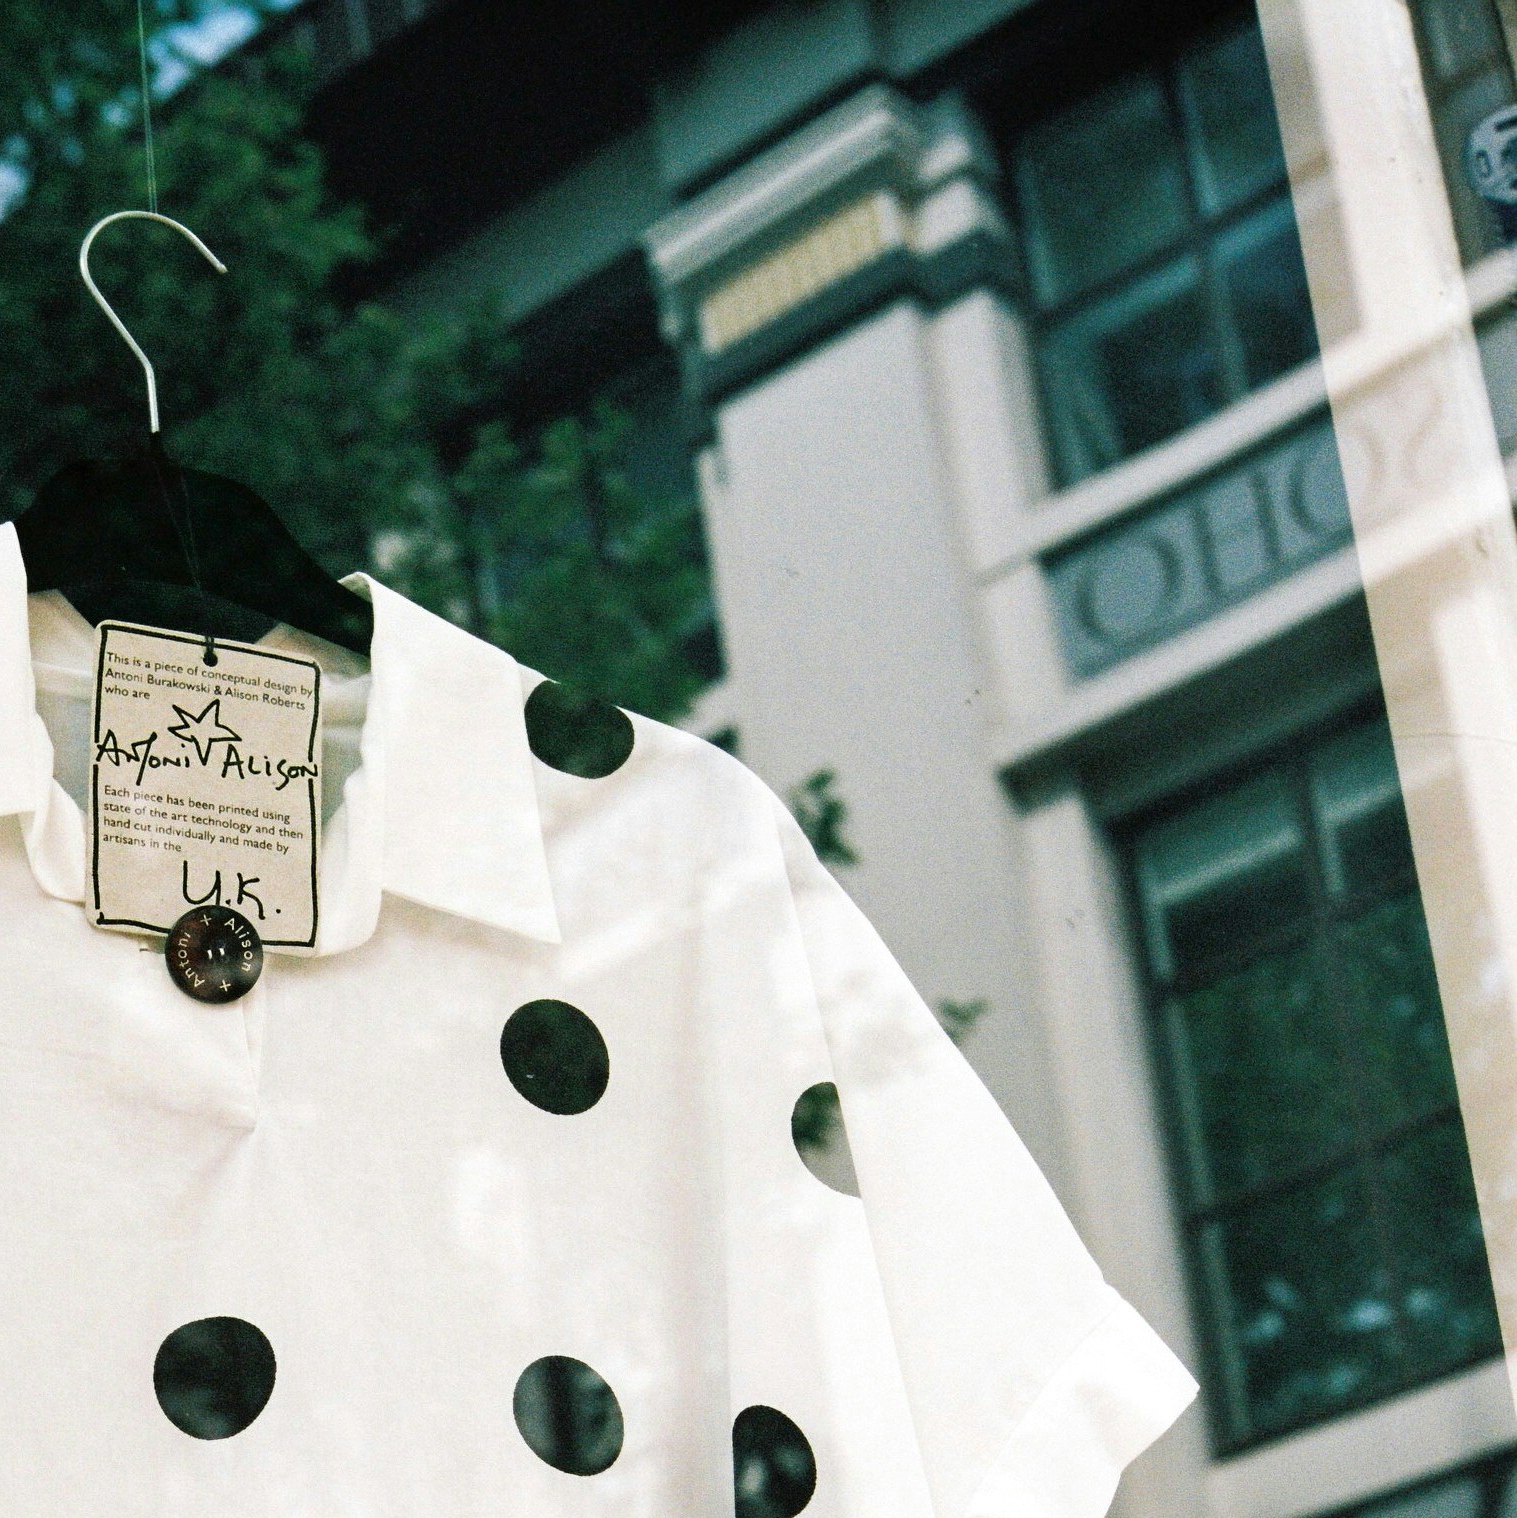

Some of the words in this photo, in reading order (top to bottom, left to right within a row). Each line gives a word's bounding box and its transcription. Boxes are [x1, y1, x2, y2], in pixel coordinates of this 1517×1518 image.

[104, 685, 129, 697] who
[132, 690, 151, 700] are
[105, 668, 143, 682] Antoni
[147, 674, 211, 693] Burakowski
[214, 685, 222, 696] &
[225, 687, 259, 701] Alison
[262, 693, 306, 711] Roberts
[106, 651, 130, 665] This
[133, 656, 141, 667] is
[144, 660, 151, 669] a
[154, 661, 183, 673] piece
[187, 666, 199, 676] of
[201, 670, 261, 686] conceptual
[263, 679, 297, 695] design
[300, 685, 313, 698] by
[103, 803, 131, 814] state
[134, 806, 147, 816] of
[149, 808, 168, 819] the
[171, 813, 188, 822] art
[191, 815, 253, 834] technology
[255, 825, 275, 836] and
[278, 828, 304, 840] then
[104, 785, 130, 798] Each
[133, 792, 163, 803] piece
[166, 794, 185, 806] has
[188, 797, 215, 811] been
[218, 804, 259, 818] printed
[262, 810, 291, 825] using
[103, 816, 131, 829] hand
[133, 822, 152, 832] cut
[155, 824, 216, 844] individually
[219, 835, 239, 846] and
[243, 838, 273, 851] made
[276, 841, 289, 855] by
[103, 834, 146, 847] artisans
[149, 838, 160, 849] in
[163, 841, 182, 853] the
[182, 860, 281, 919] U.K.
[177, 931, 206, 988] Antoni
[224, 917, 254, 972] Alison
